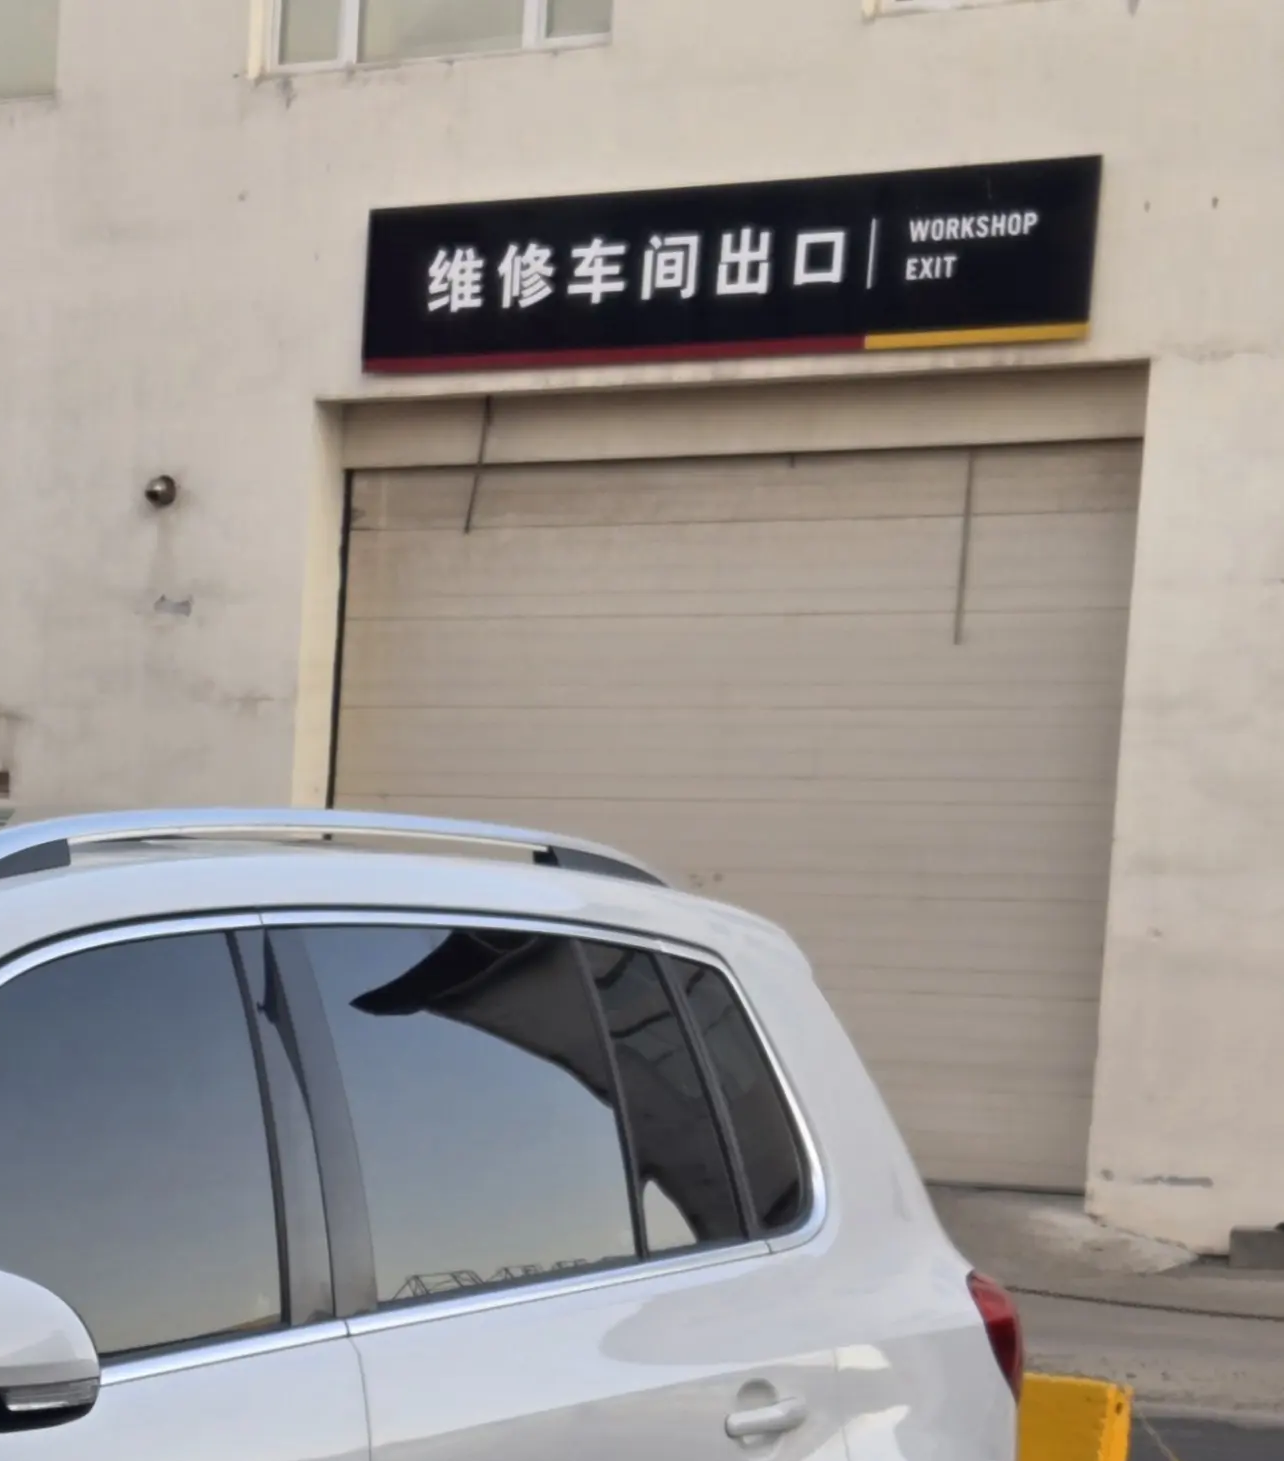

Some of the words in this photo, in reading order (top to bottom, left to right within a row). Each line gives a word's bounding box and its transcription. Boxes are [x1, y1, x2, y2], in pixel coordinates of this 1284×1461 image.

[909, 211, 1039, 243] WORKSHOP
[427, 226, 846, 313] 维修车间出口
[905, 255, 958, 281] EXIT
